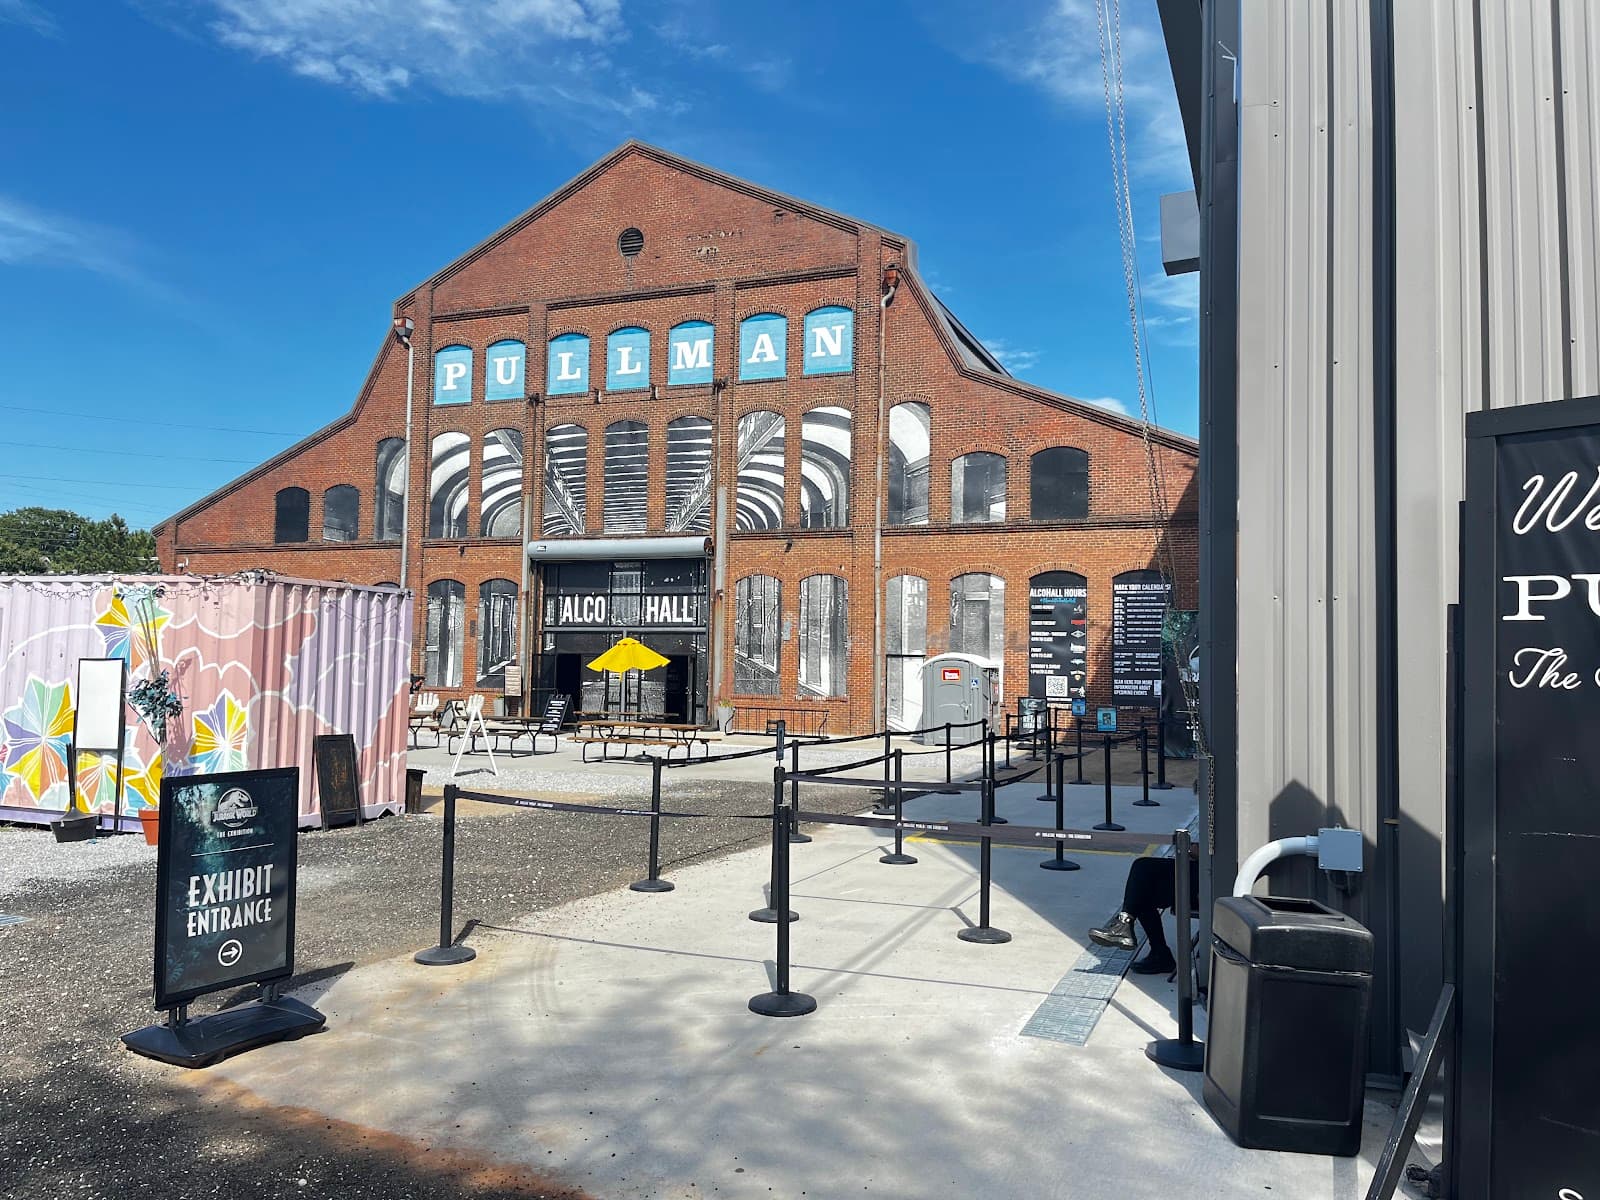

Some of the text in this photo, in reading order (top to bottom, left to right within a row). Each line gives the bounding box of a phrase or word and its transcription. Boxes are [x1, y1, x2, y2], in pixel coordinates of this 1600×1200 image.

[442, 325, 846, 392] PULLMAN
[562, 595, 693, 623] ALCO HALL
[1030, 587, 1087, 598] ALCOHALL HOURS
[1508, 647, 1582, 690] The
[187, 864, 274, 908] EXHIBIT
[187, 897, 272, 938] ENTRANCE
